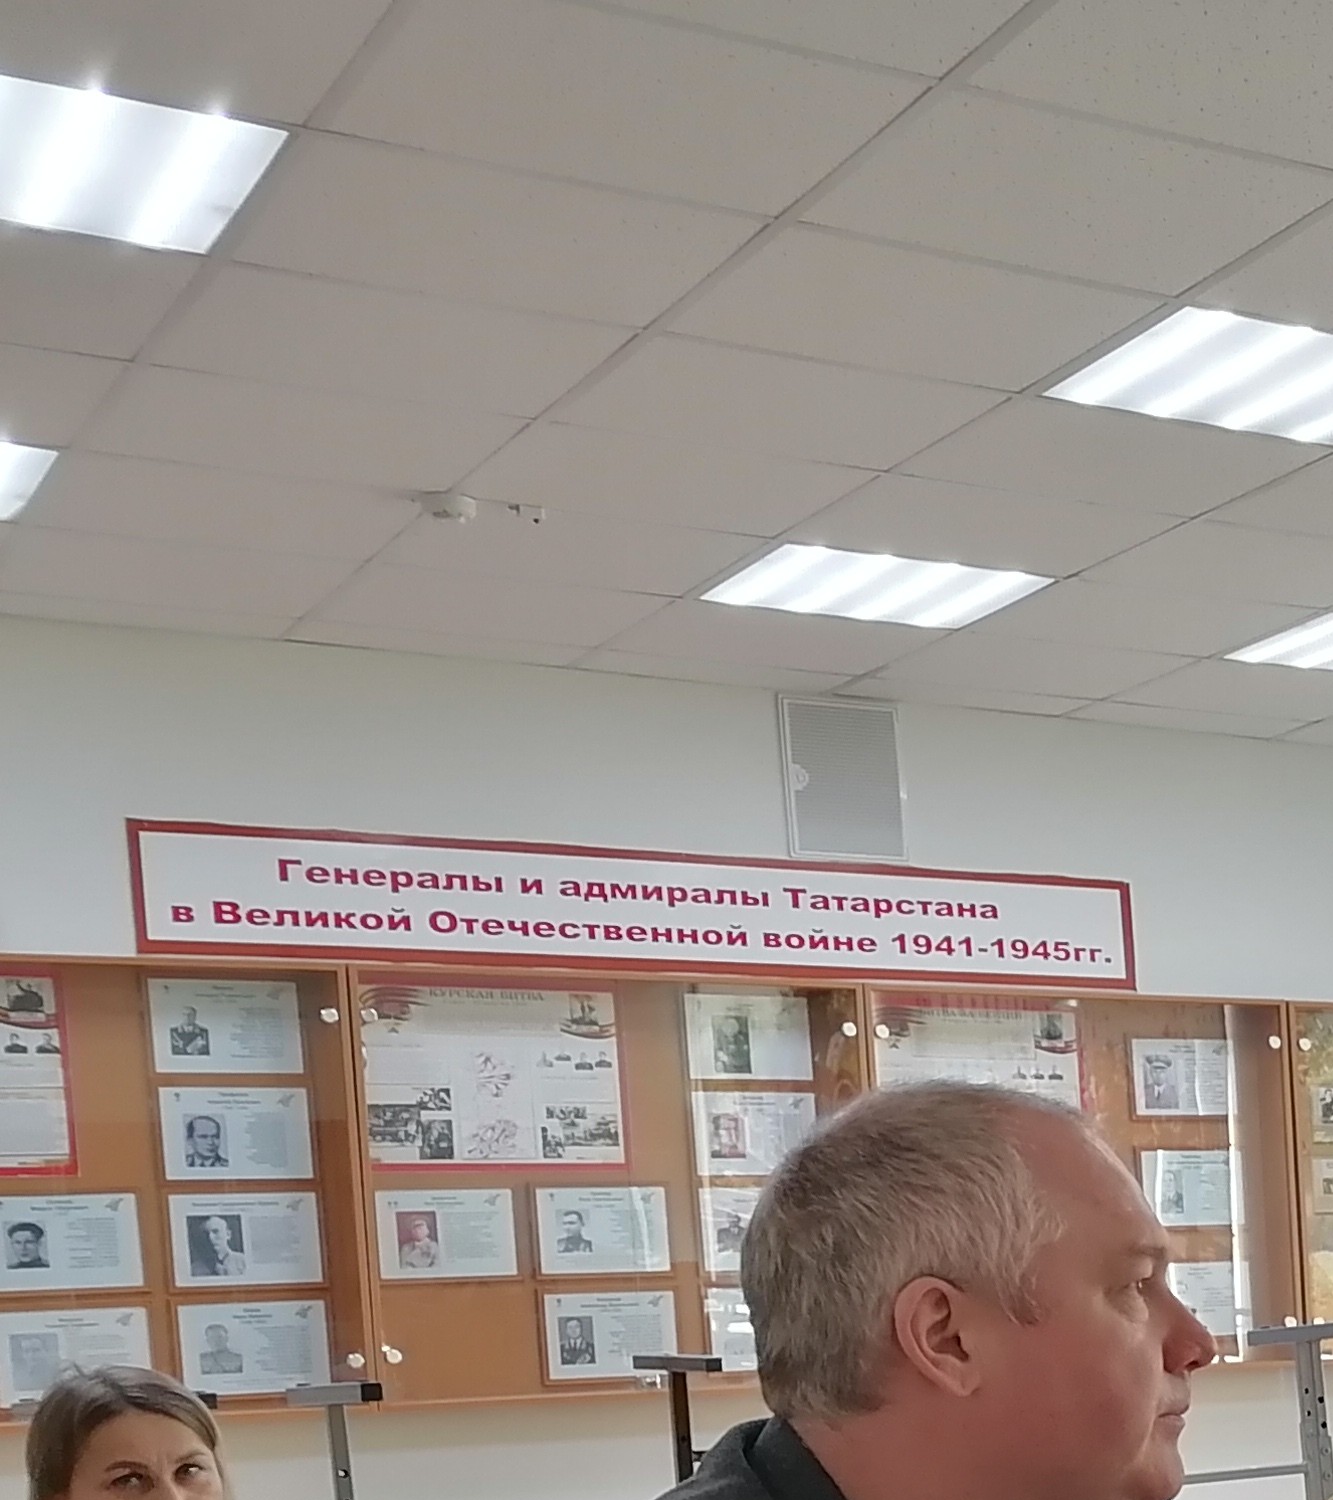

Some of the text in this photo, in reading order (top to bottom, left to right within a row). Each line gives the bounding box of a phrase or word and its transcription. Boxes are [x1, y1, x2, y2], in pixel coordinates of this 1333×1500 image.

[277, 858, 999, 920] Генералы и адмиралы Татарстана
[171, 900, 1113, 964] в Великой Отечественной войне 1941-1945гг.
[428, 988, 494, 1000] КУРСКАЯ
